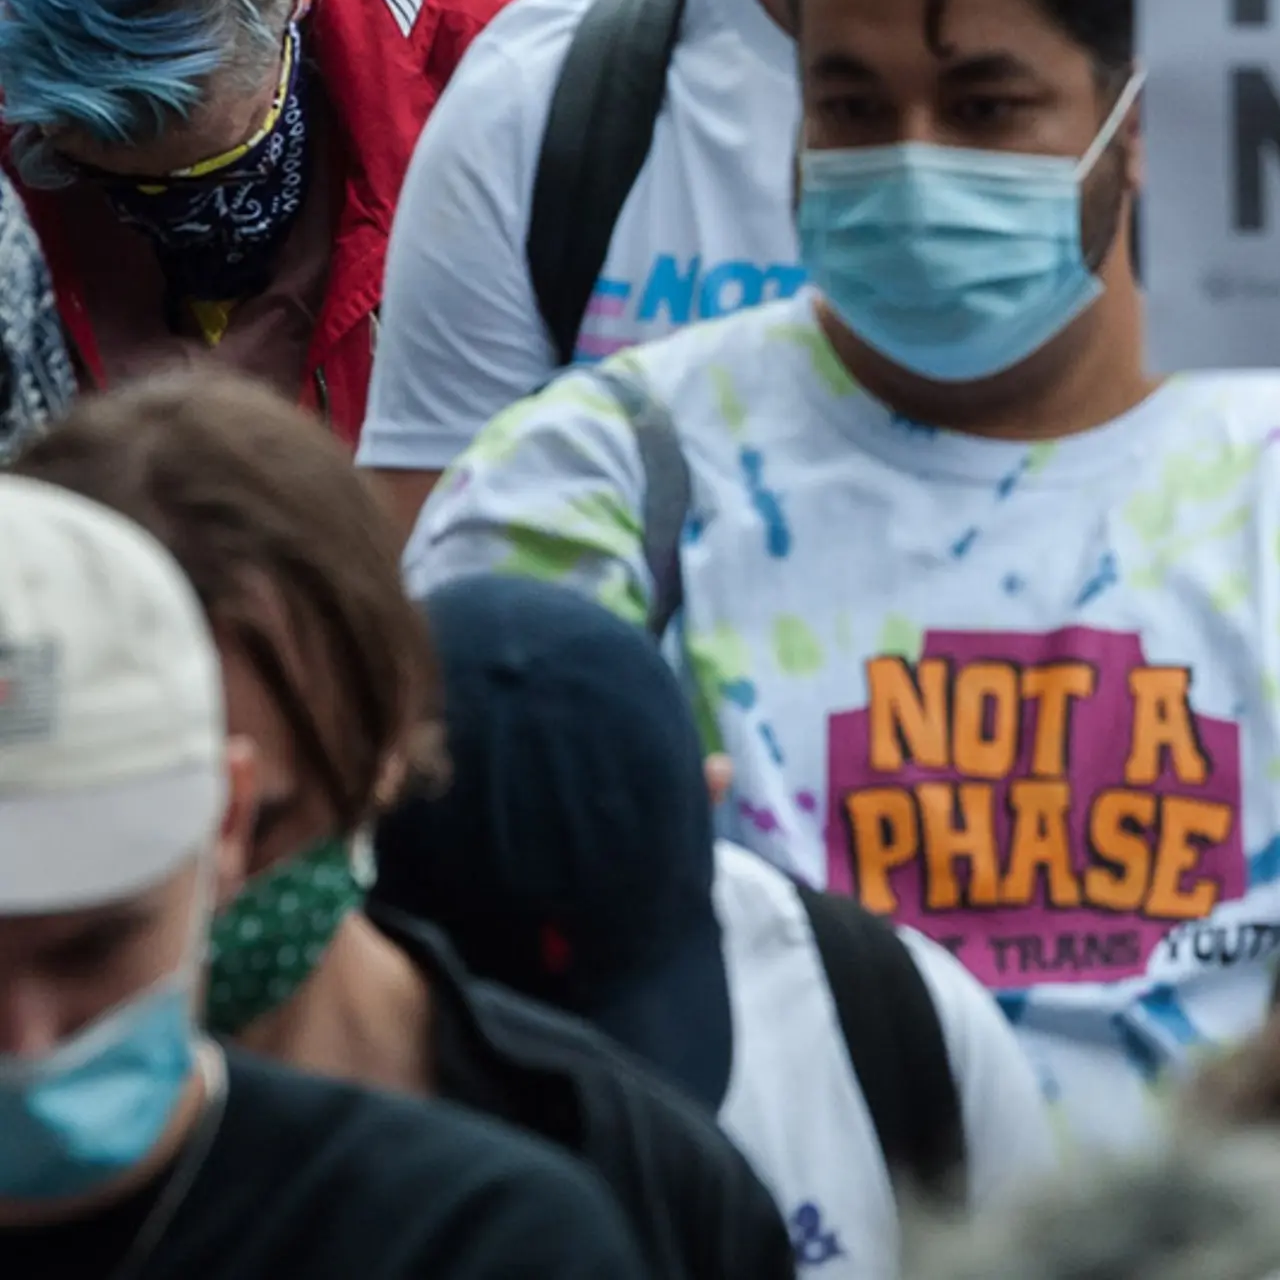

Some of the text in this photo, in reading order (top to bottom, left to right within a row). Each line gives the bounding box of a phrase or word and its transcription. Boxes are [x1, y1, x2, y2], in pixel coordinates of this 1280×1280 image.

[866, 654, 1211, 786] NOT A
[845, 778, 1233, 919] PHASE
[988, 928, 1142, 974] TRANS
